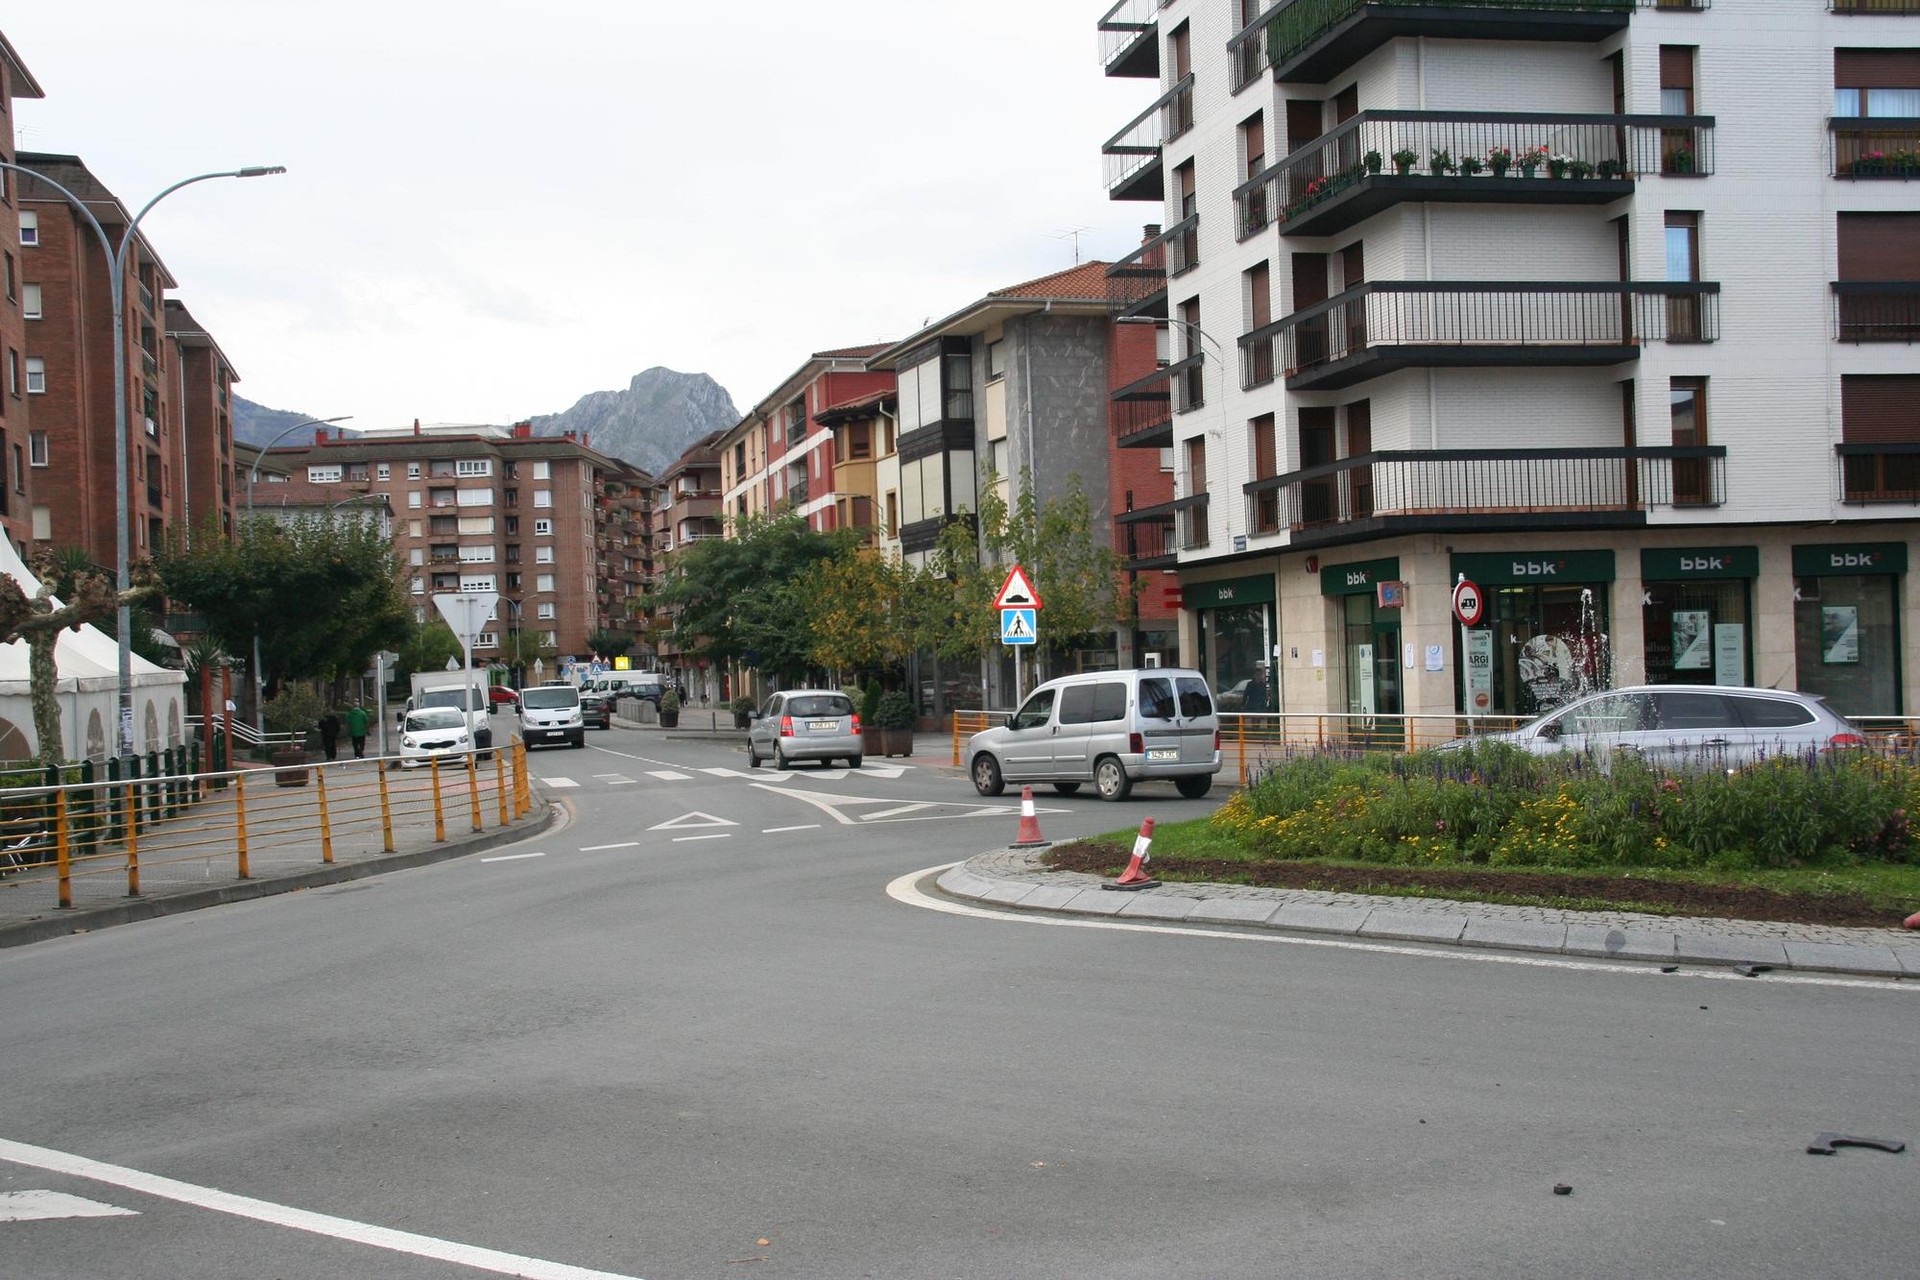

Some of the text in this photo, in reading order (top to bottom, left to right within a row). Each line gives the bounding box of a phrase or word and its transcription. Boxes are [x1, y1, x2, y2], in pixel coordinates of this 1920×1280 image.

[1680, 556, 1723, 571] bbk
[1830, 553, 1872, 567] bbk
[1512, 561, 1556, 575] bbk
[1346, 571, 1367, 585] bbk
[1218, 588, 1234, 600] bbk
